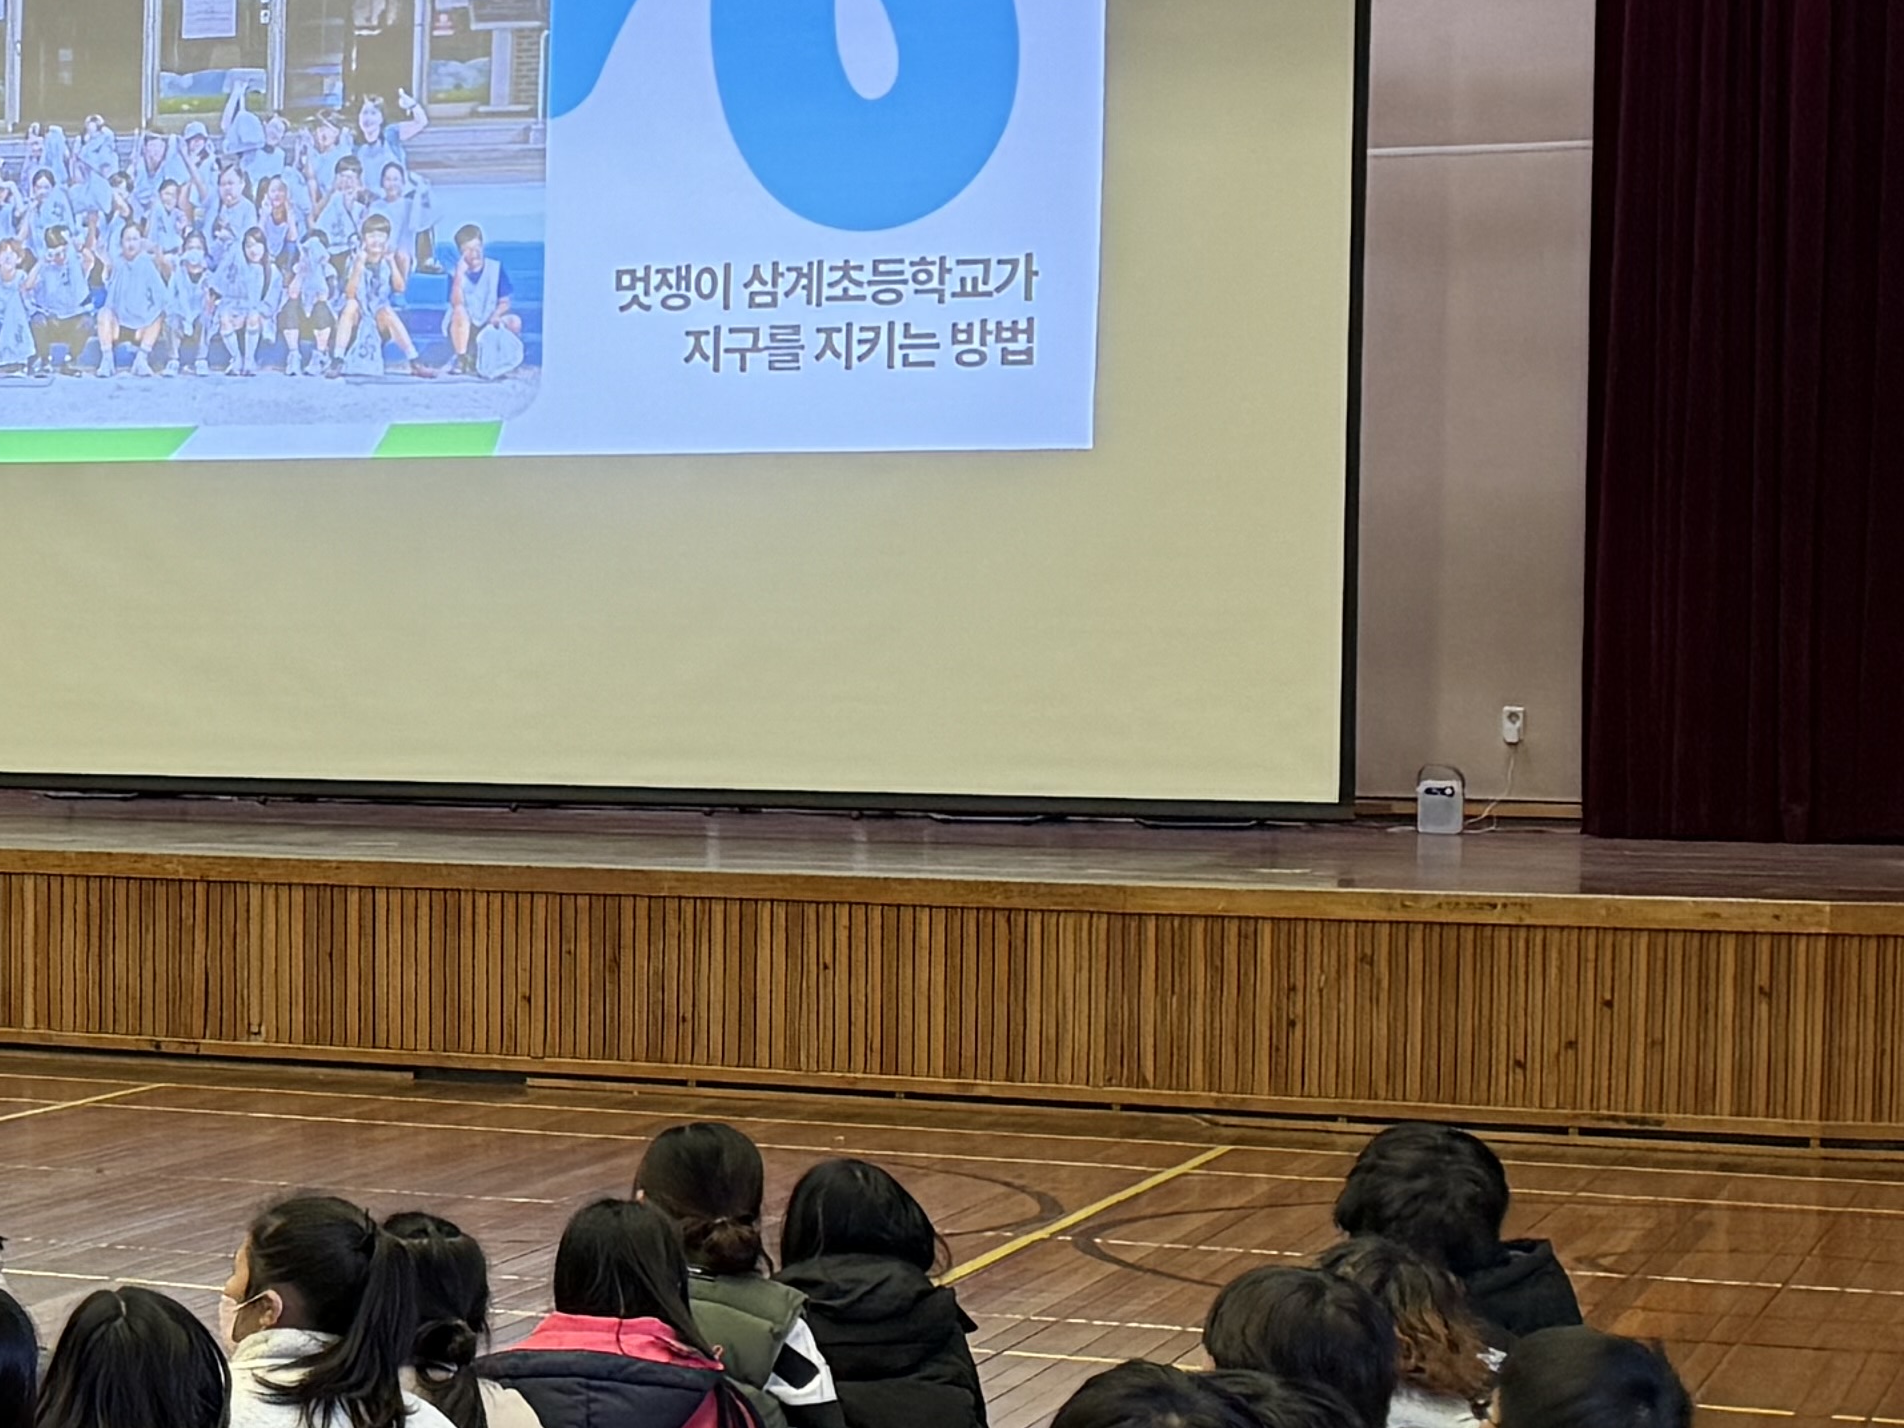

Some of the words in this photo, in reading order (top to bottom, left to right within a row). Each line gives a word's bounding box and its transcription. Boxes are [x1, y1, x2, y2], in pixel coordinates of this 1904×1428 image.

[614, 261, 732, 312] 멋쟁이
[742, 252, 1040, 310] 삼계초등학교가
[683, 324, 805, 373] 지구를
[814, 320, 941, 370] 지키는
[950, 317, 1035, 367] 방법
